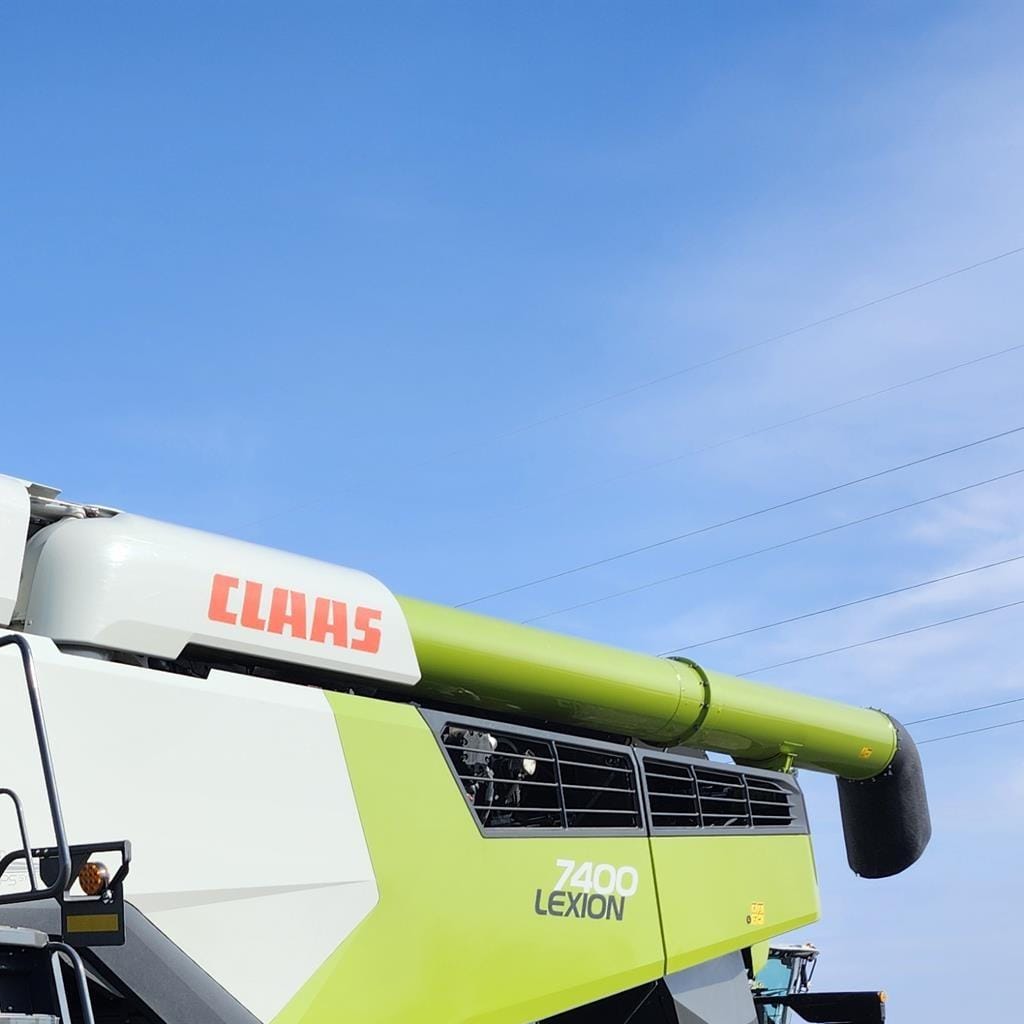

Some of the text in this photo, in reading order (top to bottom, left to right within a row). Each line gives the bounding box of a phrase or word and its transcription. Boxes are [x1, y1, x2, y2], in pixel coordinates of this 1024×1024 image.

[208, 573, 382, 655] CLAAS
[554, 858, 639, 897] 7400
[534, 888, 626, 922] LEXION
